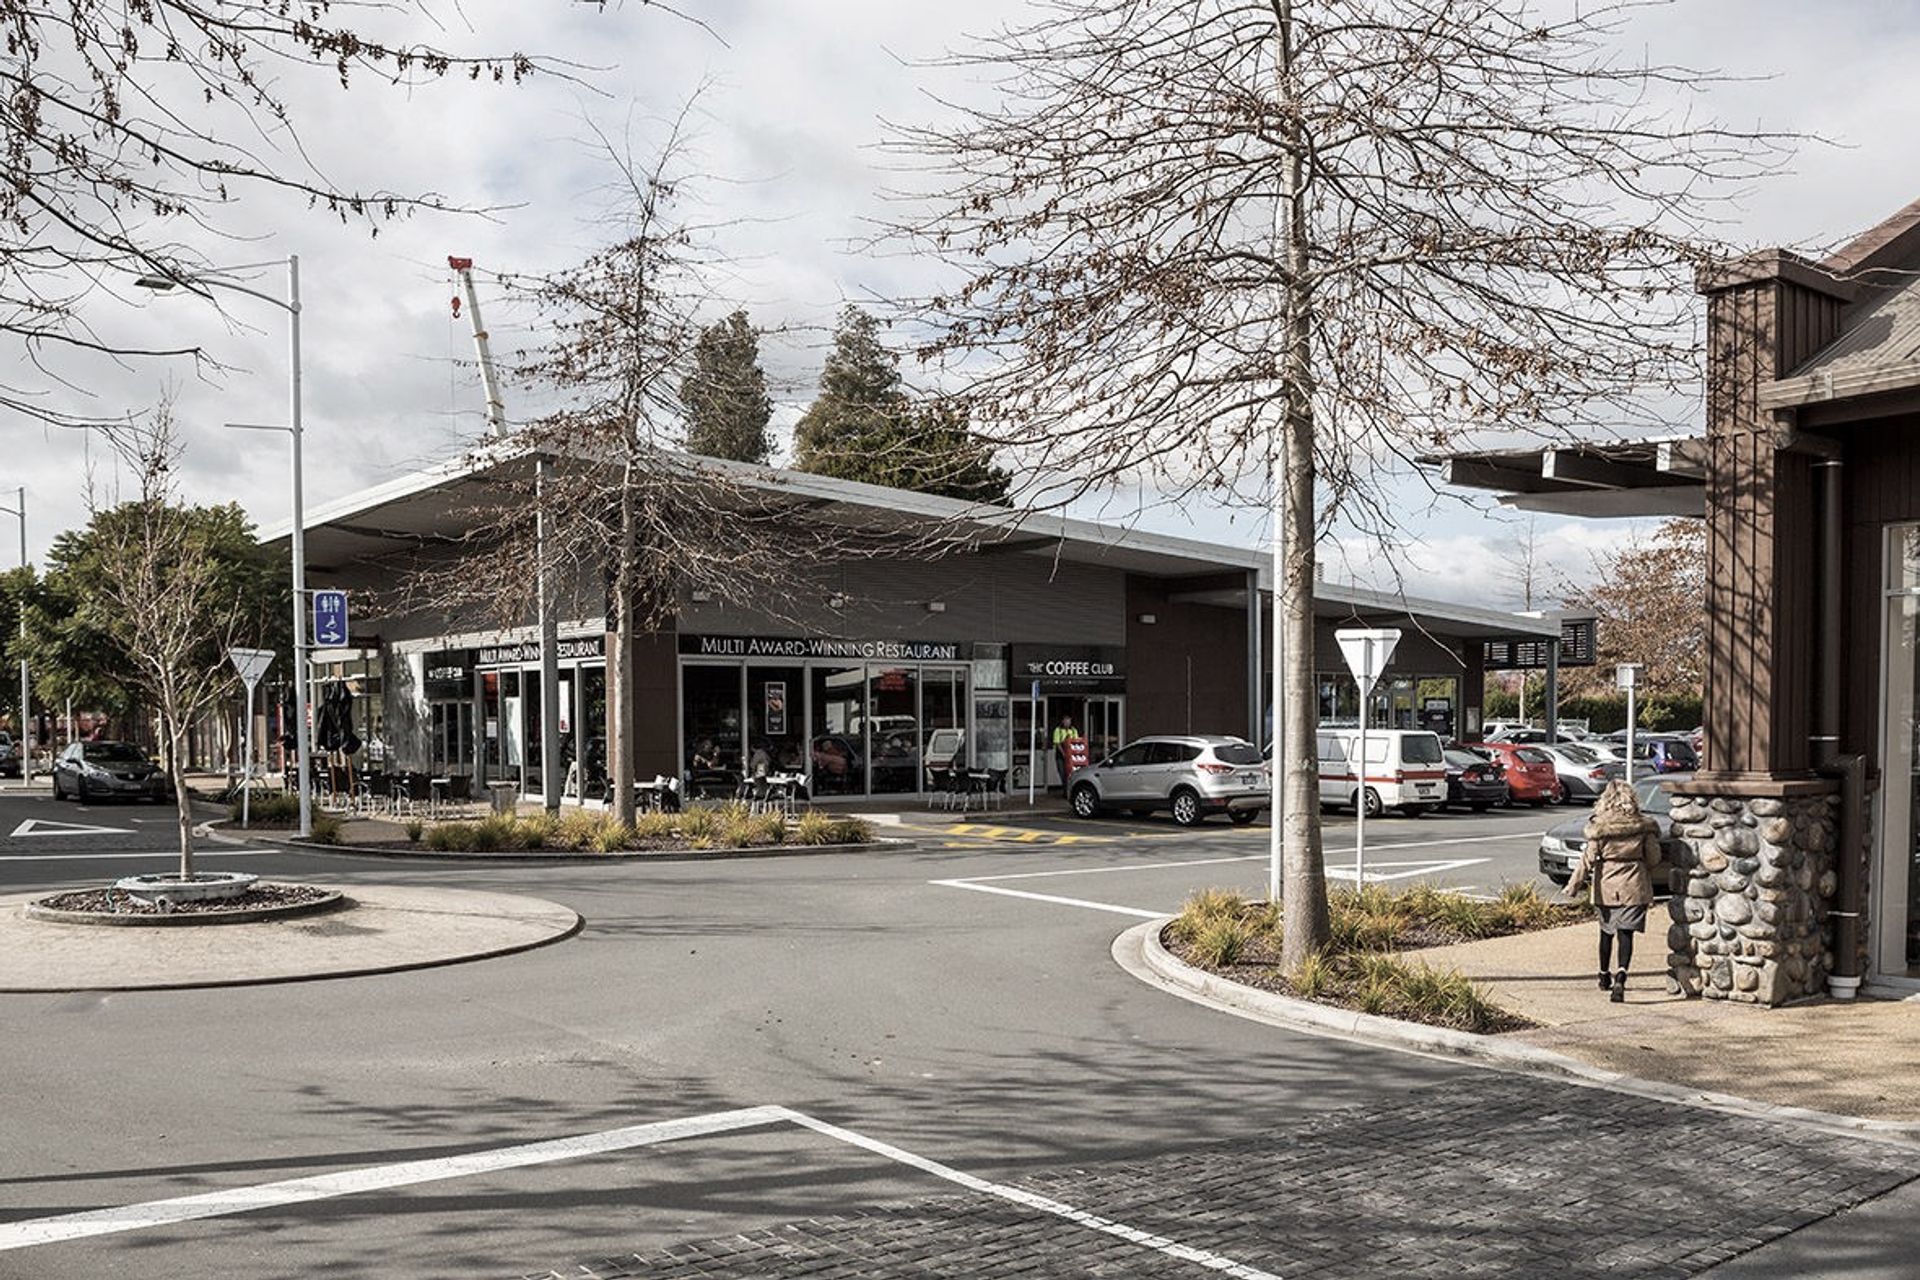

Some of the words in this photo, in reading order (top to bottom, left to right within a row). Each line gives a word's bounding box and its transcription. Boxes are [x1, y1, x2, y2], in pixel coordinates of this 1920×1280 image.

[701, 637, 744, 654] MULTI
[748, 640, 874, 658] AWARD-WINNING
[877, 641, 957, 659] RESTAURANT
[1045, 660, 1089, 675] COFFEE
[1091, 663, 1114, 675] CLUB
